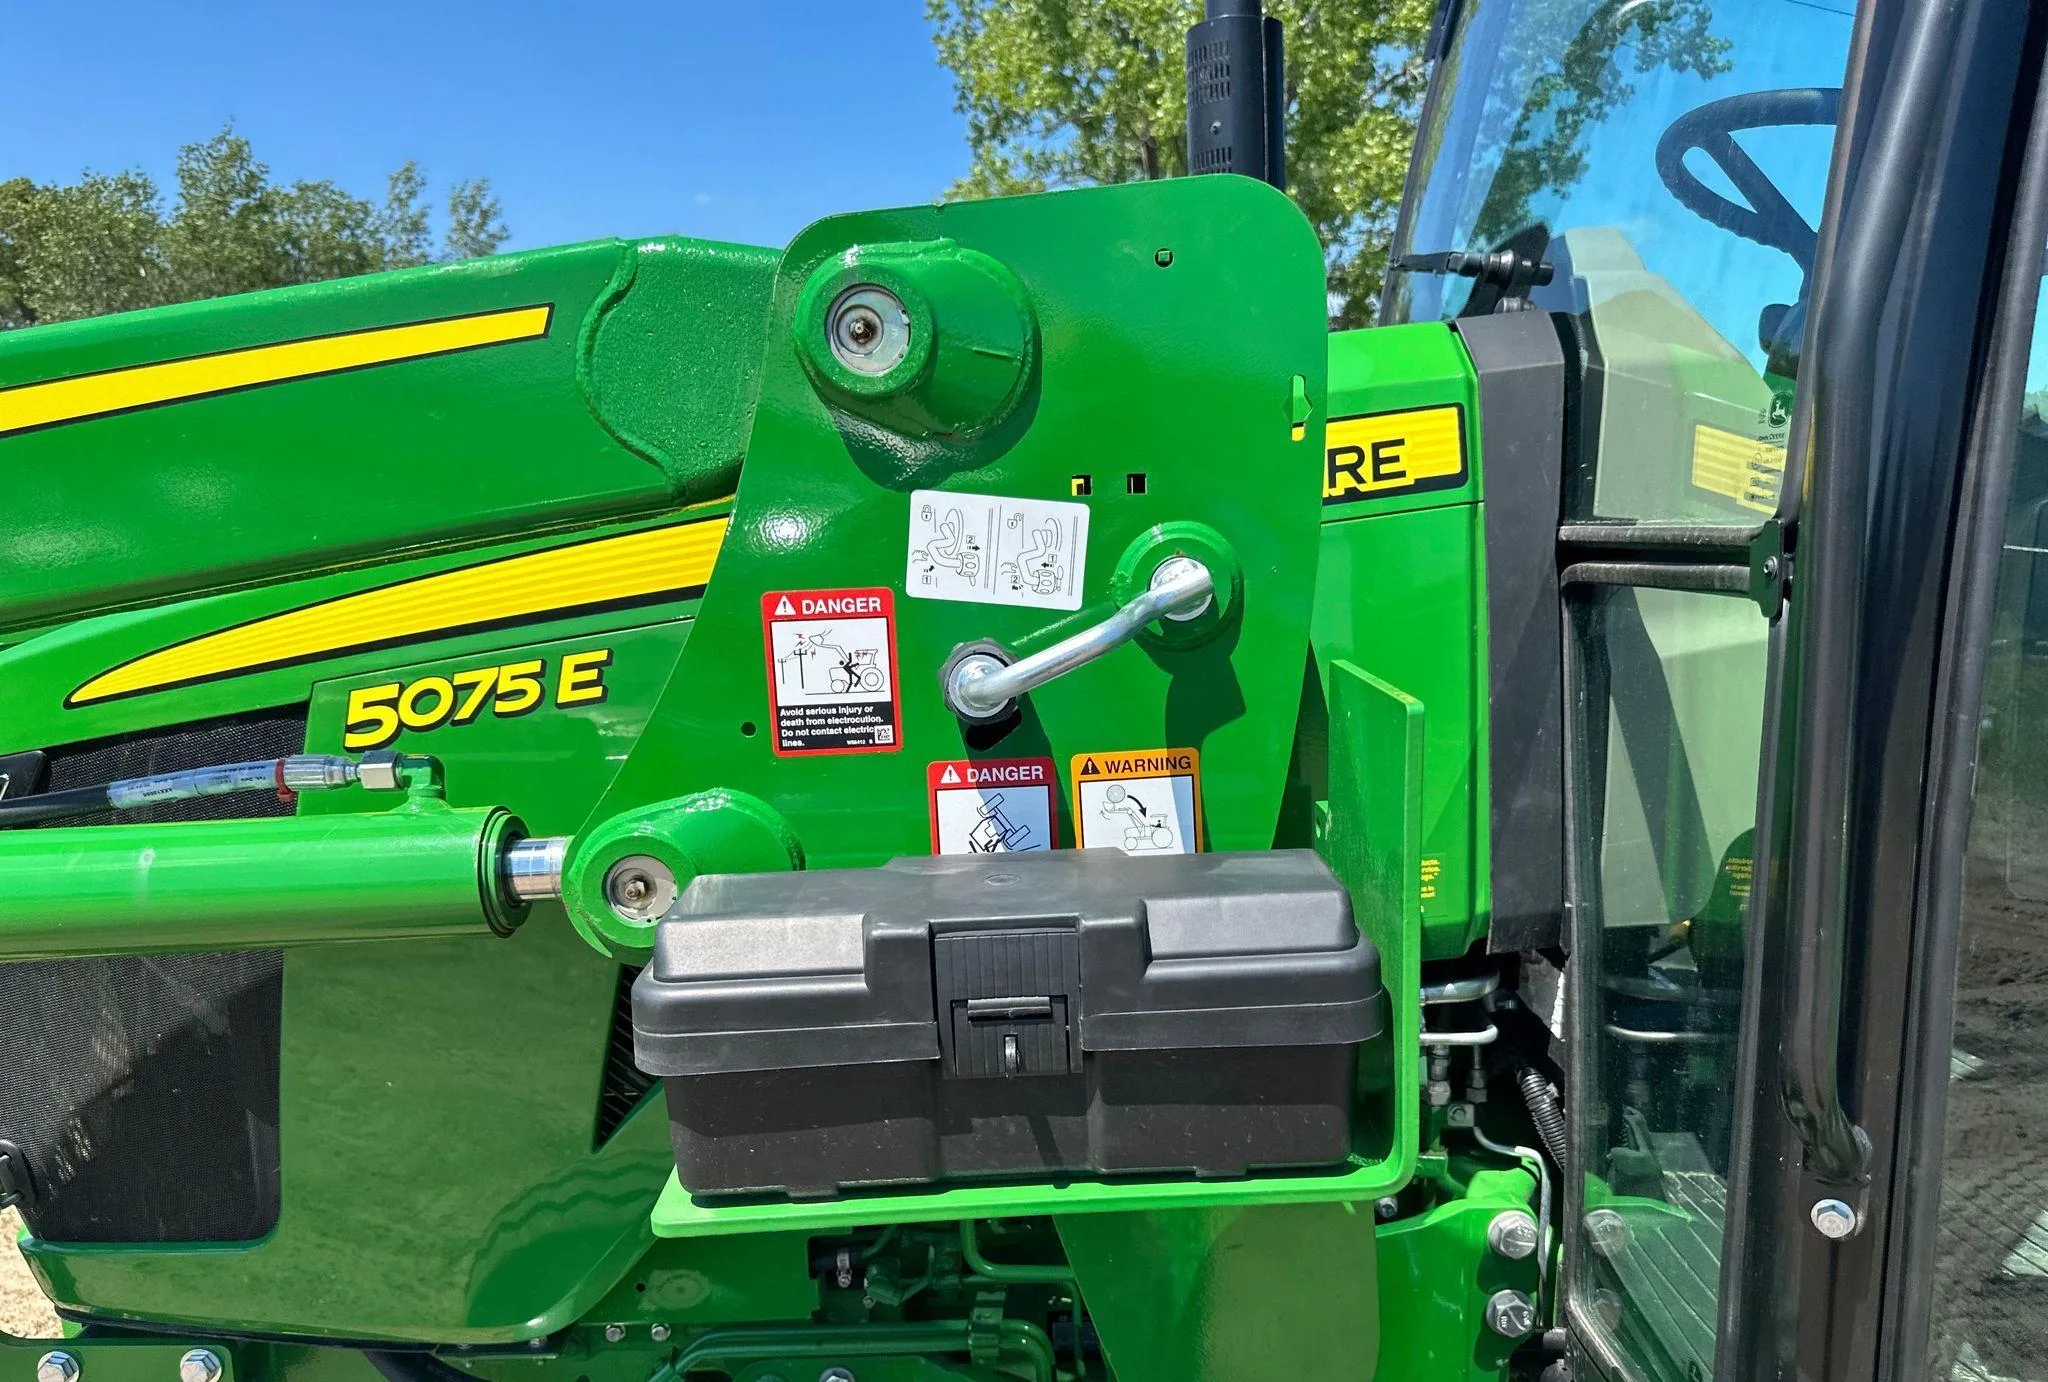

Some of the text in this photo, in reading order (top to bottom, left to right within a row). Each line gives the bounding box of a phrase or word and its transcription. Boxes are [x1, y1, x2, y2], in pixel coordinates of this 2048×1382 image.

[1327, 438, 1407, 489] RE
[802, 597, 882, 615] DANGER
[343, 649, 611, 752] 5075 E
[780, 708, 804, 717] Avoid
[805, 706, 837, 716] serious
[838, 705, 862, 715] injury
[780, 715, 884, 727] death from electrocution.
[781, 729, 794, 737] Do
[795, 728, 809, 736] not
[811, 727, 842, 736] contact
[782, 739, 805, 747] lines.
[1104, 755, 1192, 774] WARNING
[966, 765, 1044, 783] DANGER
